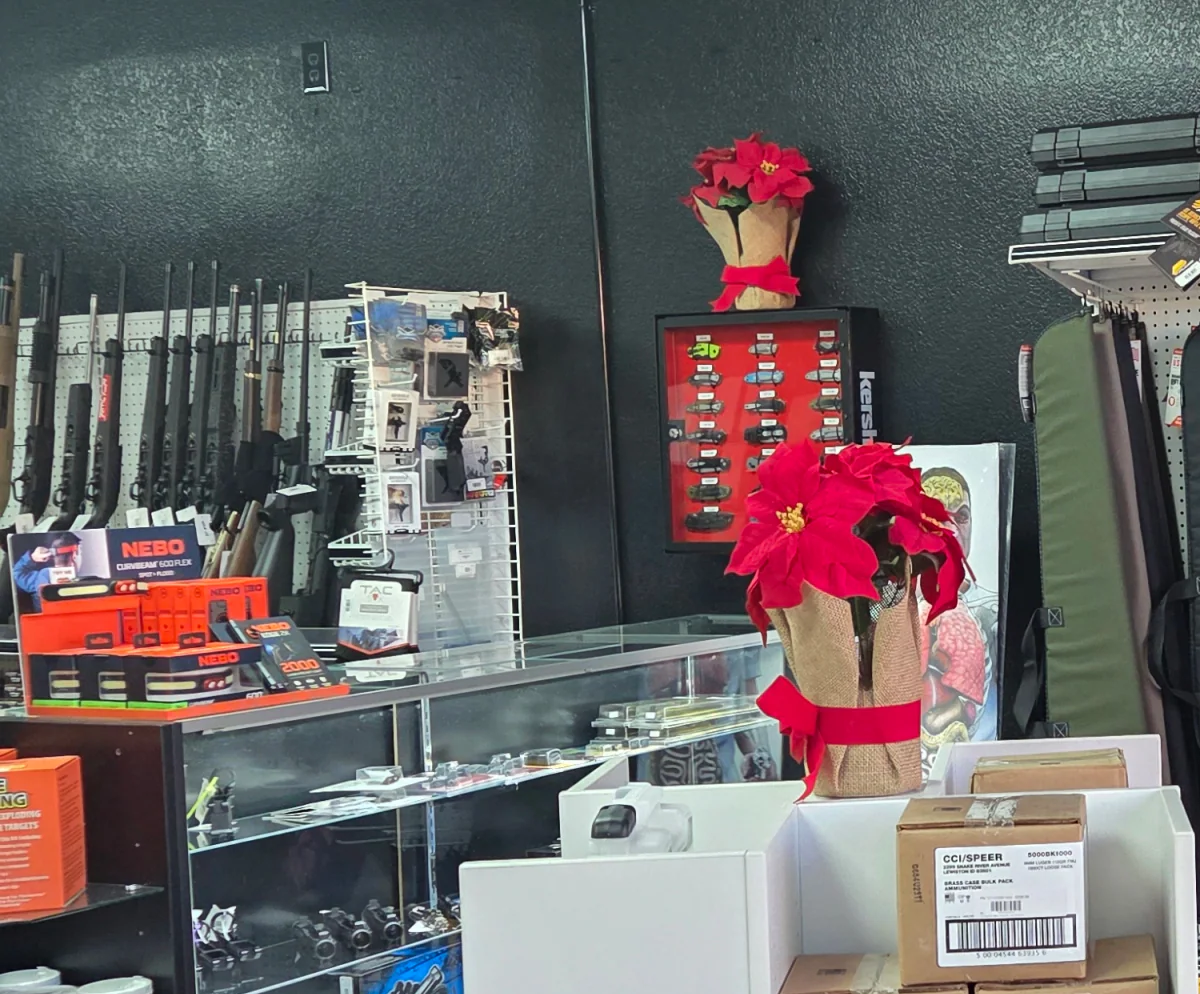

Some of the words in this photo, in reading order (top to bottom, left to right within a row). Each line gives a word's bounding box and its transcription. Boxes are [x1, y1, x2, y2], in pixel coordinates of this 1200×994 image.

[859, 371, 877, 445] kersh
[122, 539, 185, 558] NEBO
[210, 587, 240, 596] NEBO
[360, 585, 392, 594] TAC
[198, 652, 239, 666] NEBO
[281, 660, 319, 672] 2000
[943, 854, 1003, 863] CCI/SPEER
